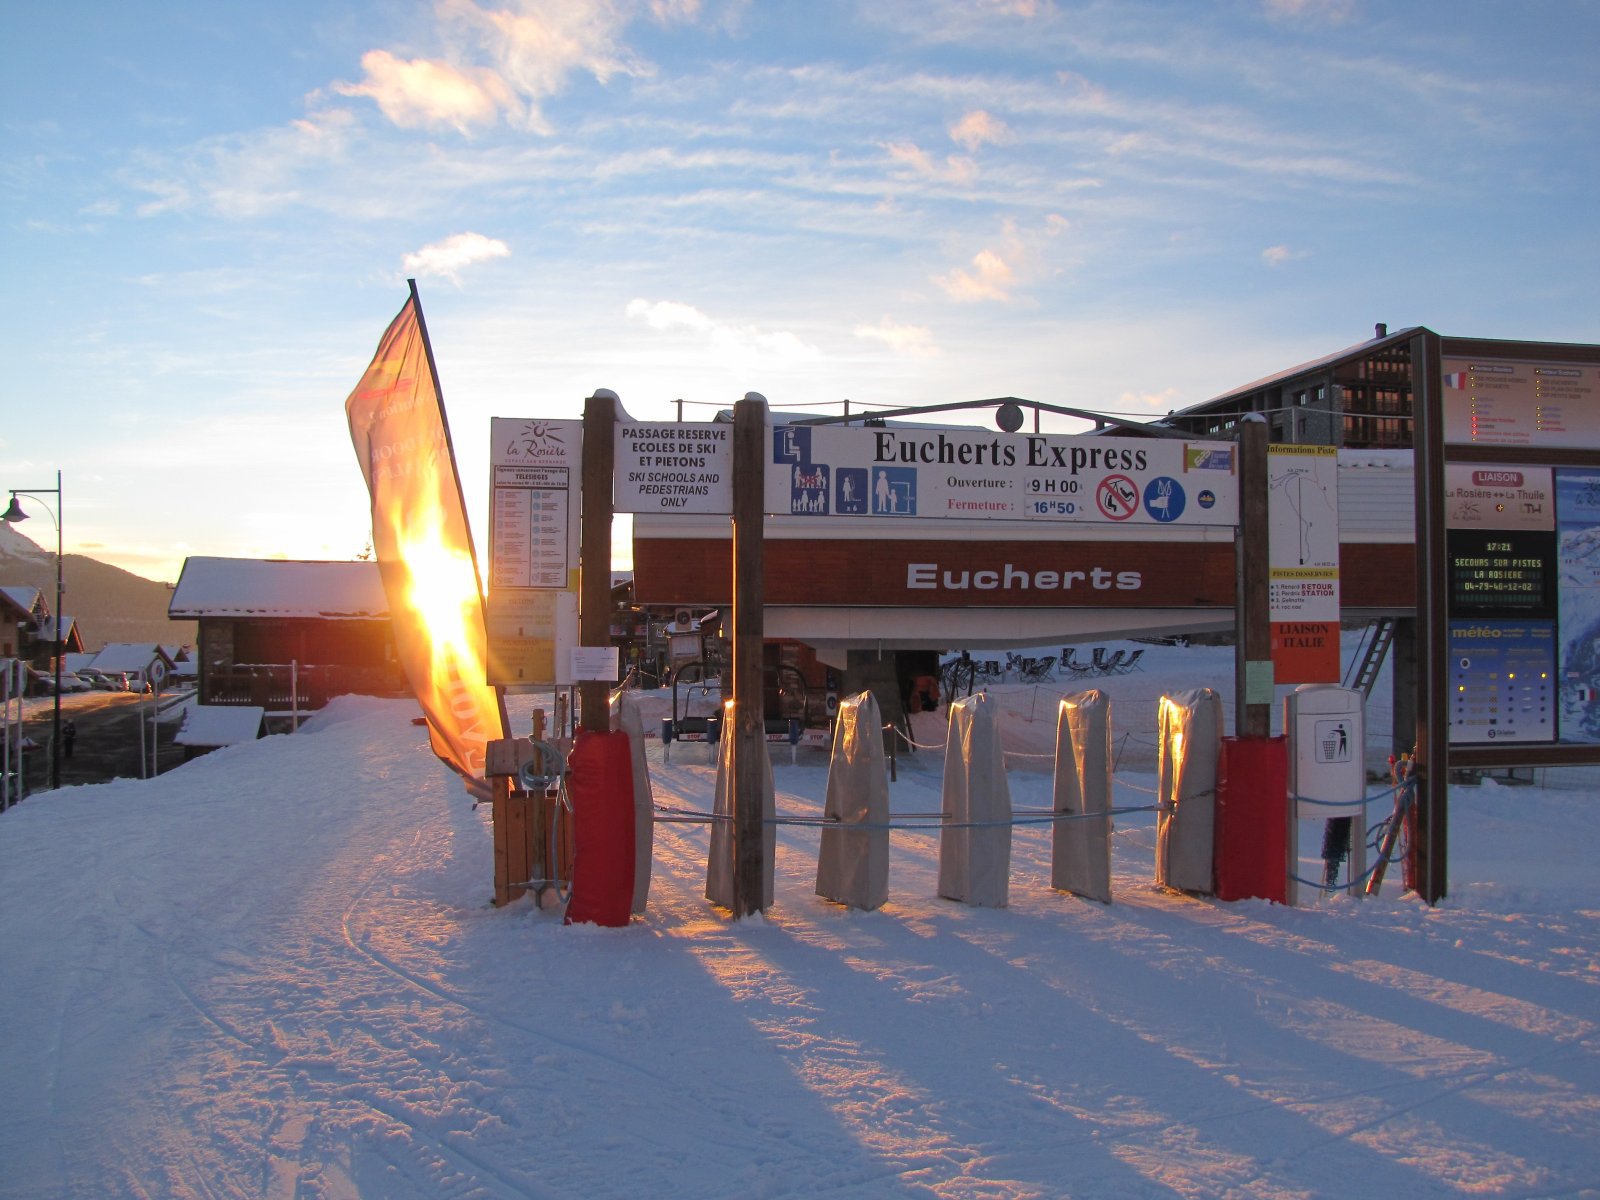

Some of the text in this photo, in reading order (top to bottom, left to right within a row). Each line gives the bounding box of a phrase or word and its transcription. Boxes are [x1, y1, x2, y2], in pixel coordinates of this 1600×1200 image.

[622, 428, 727, 440] PASSAGE RESERVE
[507, 439, 568, 458] la Rosière
[632, 442, 716, 454] ECOLES DE SKI
[873, 431, 1148, 476] Eucherts Express
[1266, 445, 1315, 454] Informations
[639, 456, 706, 467] ET PIETONS
[628, 472, 720, 483] SKI SCHOOLS AND
[947, 475, 1005, 489] Ouverture
[1478, 472, 1517, 482] LIAISON
[638, 484, 709, 495] PEDESTRIANS
[1031, 479, 1078, 494] 9 H 00
[1445, 488, 1545, 501] La Rosière La Thuile
[660, 497, 688, 507] ONLY
[947, 498, 1007, 511] Fermeture
[1487, 542, 1511, 552] 17:21
[1454, 558, 1542, 568] SECOURS SUR PISTES
[906, 562, 1142, 591] Eucherts
[1474, 570, 1523, 579] LA ROSIERE
[1464, 581, 1534, 591] 04-79-40-12-02
[1279, 623, 1329, 634] LIAISON
[1452, 625, 1502, 638] météo
[1283, 637, 1326, 648] ITALIE
